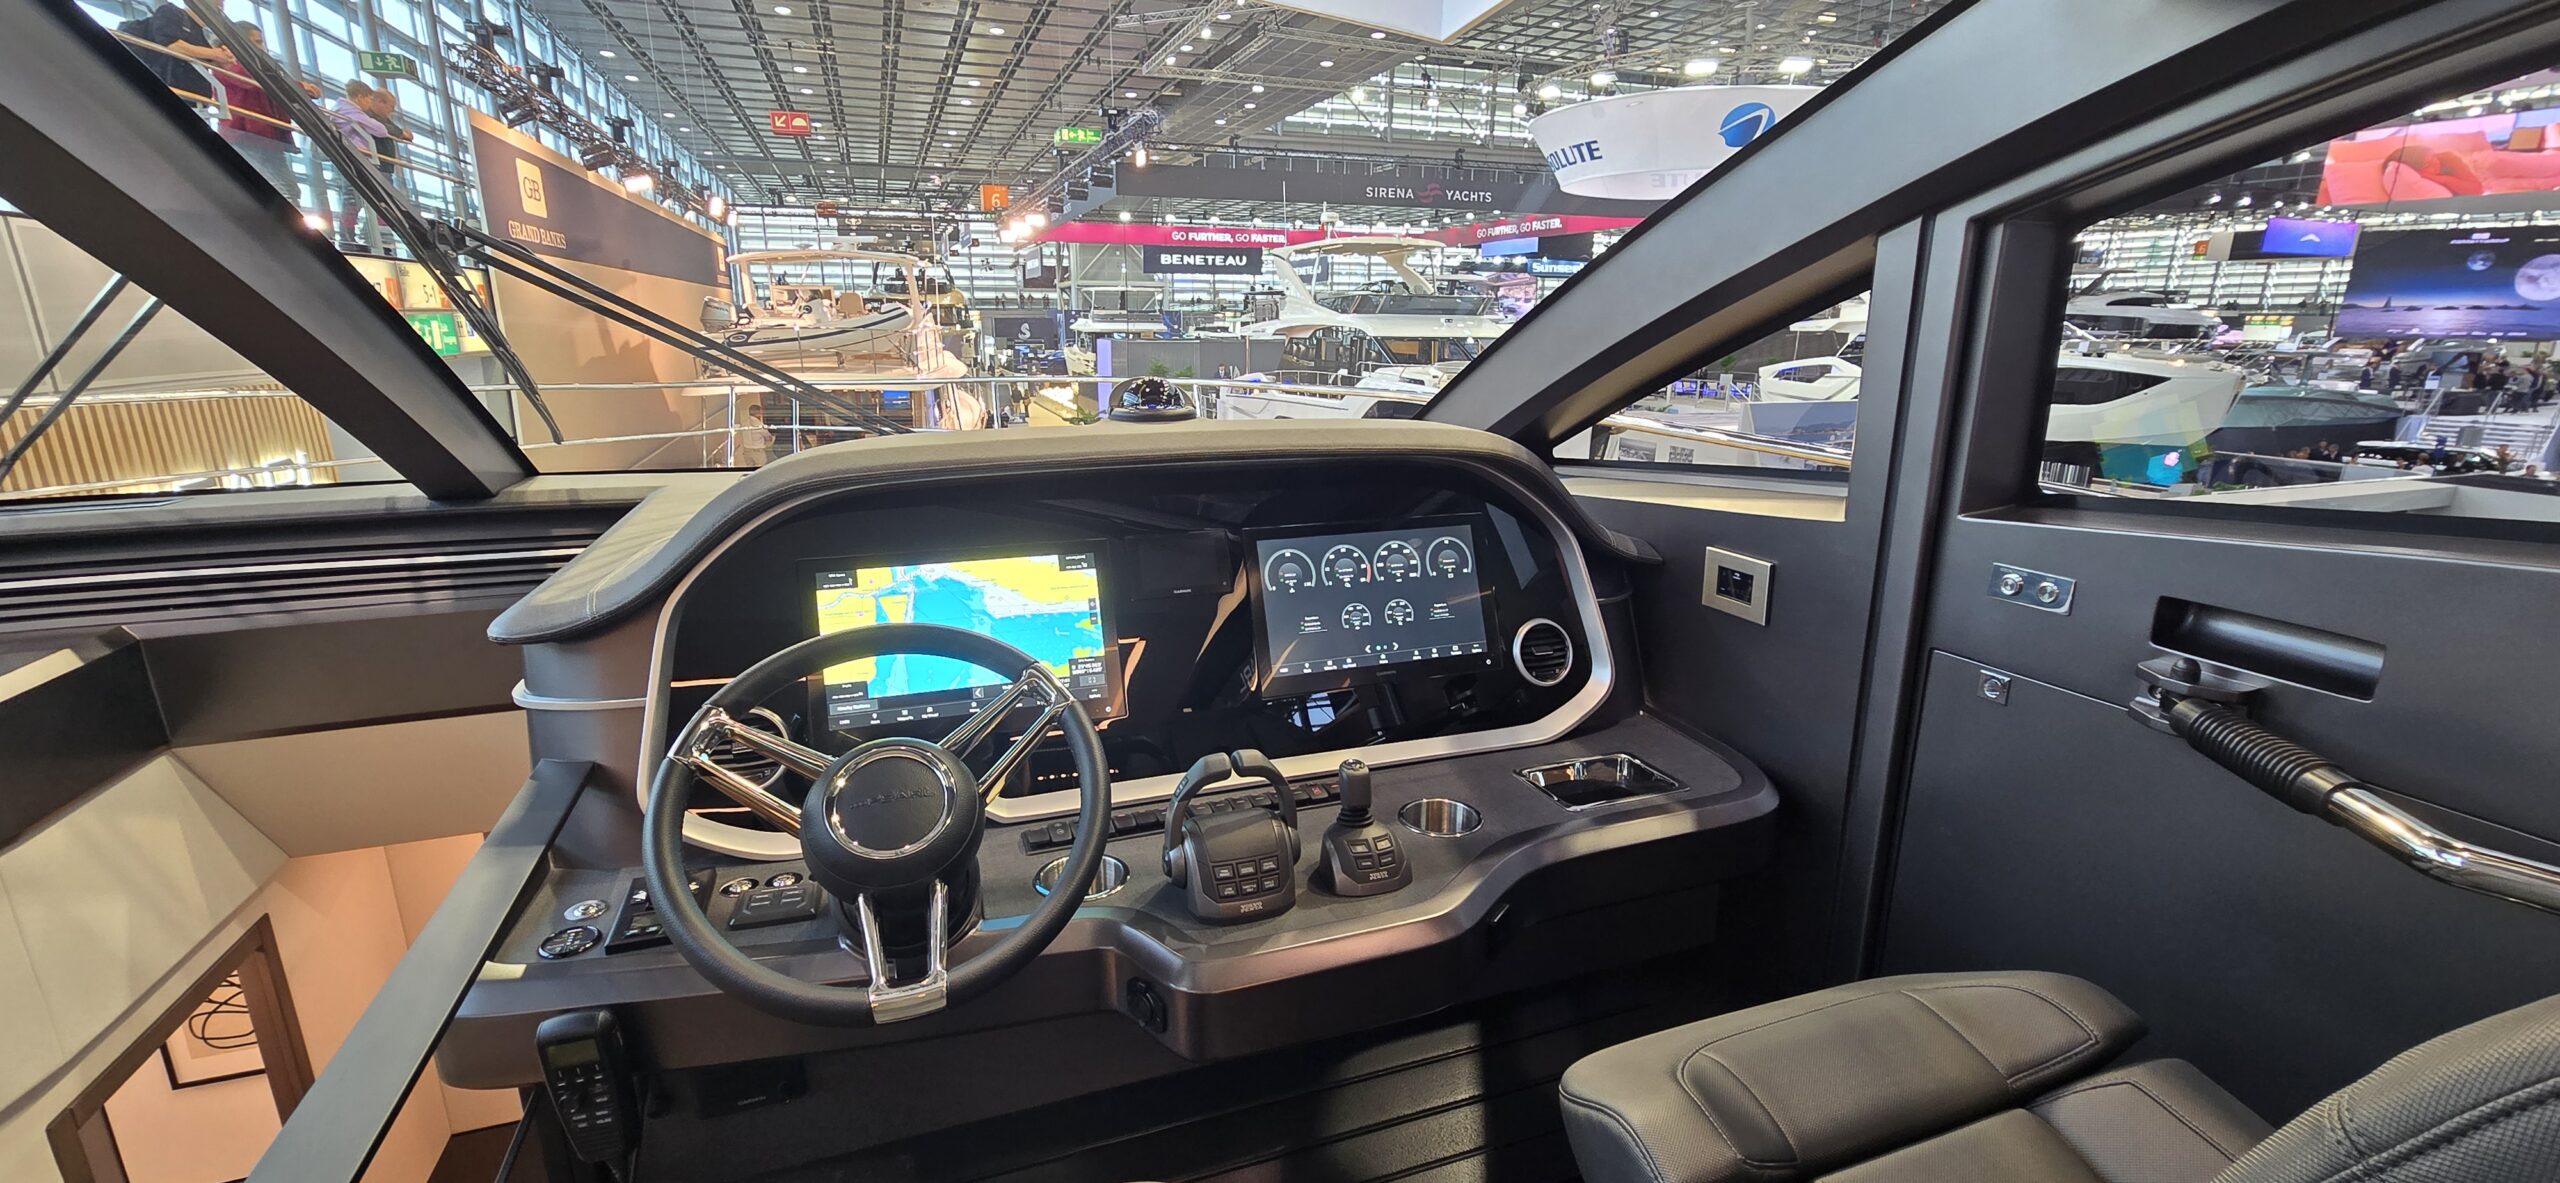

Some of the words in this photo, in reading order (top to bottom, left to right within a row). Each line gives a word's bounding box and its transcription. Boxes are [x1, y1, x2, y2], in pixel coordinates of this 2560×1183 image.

[523, 176, 541, 202] GB
[1366, 187, 1415, 199] SIRENA
[1445, 189, 1493, 203] YACHTS
[991, 193, 1001, 208] 6
[508, 220, 541, 243] GRAND
[540, 228, 567, 250] BANKS
[1477, 228, 1487, 238] GO
[1487, 224, 1519, 237] FURTHER,
[1520, 222, 1531, 233] GO
[1532, 218, 1562, 231] FASTER.
[1171, 231, 1186, 241] GO
[1188, 232, 1234, 243] FURTHER,
[1235, 233, 1249, 243] GO
[1160, 253, 1247, 267] BENETEAU
